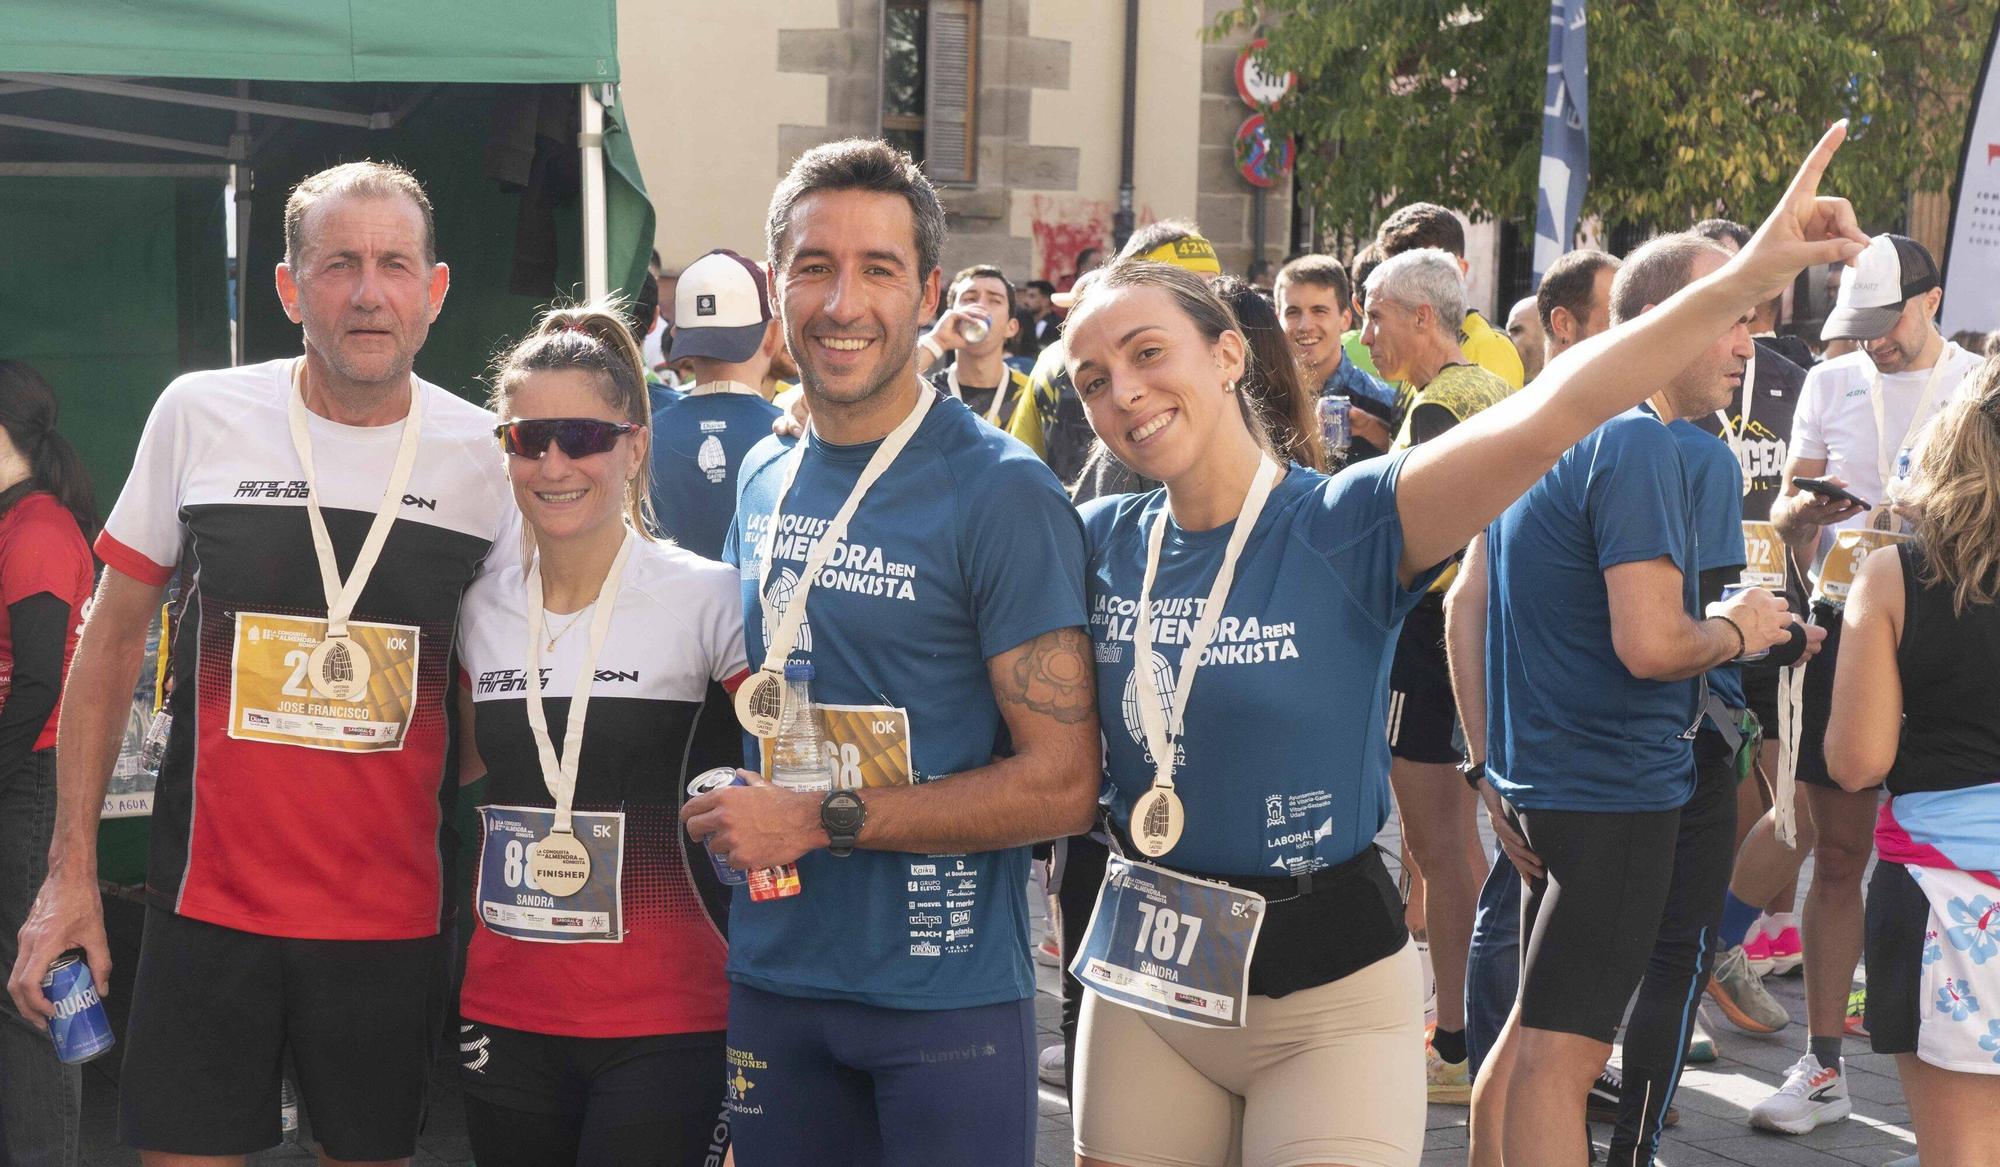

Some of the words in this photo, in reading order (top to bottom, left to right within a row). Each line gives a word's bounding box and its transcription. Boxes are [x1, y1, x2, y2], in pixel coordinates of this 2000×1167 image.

[886, 562, 916, 578] REN
[1262, 622, 1295, 640] REN
[278, 701, 305, 714] JOSE
[308, 703, 369, 720] FRANCISCO
[593, 825, 611, 838] 5K
[1268, 830, 1313, 848] LABORAL
[545, 853, 578, 861] ALMENDRA
[537, 869, 585, 879] FINISHER
[913, 867, 934, 875] Kaiku
[516, 894, 554, 909] SANDRA
[909, 912, 942, 928] udapa
[1134, 901, 1203, 967] 787
[1140, 960, 1179, 982] SANDRA
